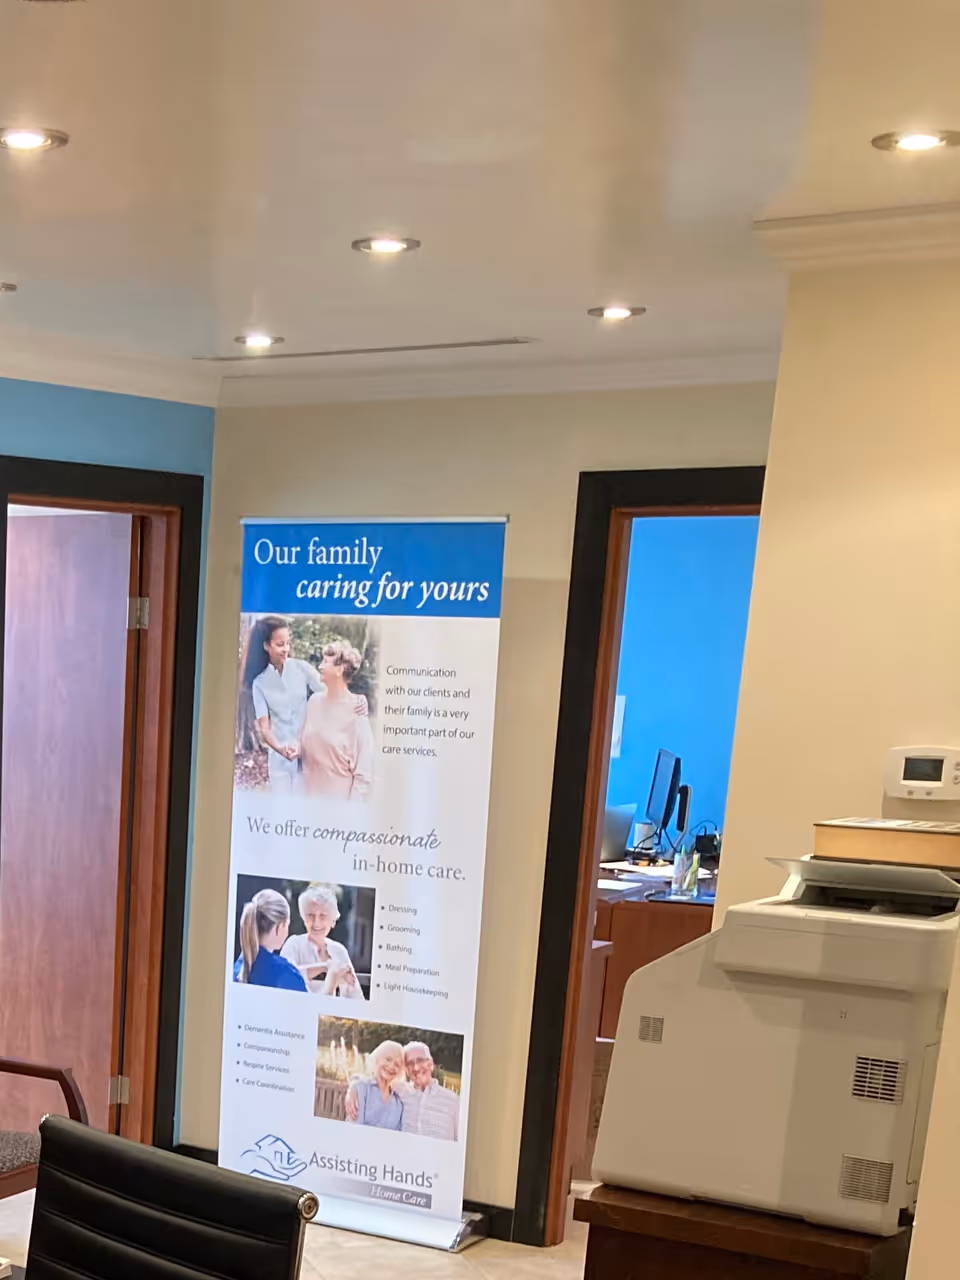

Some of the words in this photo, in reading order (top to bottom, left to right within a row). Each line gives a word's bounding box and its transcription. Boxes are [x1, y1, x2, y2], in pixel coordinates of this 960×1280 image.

[253, 538, 301, 565] Our
[307, 537, 383, 574] family
[296, 573, 374, 608] caring
[371, 571, 414, 608] for
[416, 580, 490, 609] yours
[386, 665, 457, 678] Communication
[385, 685, 406, 696] with
[407, 688, 422, 697] our
[423, 687, 451, 698] clients
[452, 688, 471, 699] and
[384, 705, 405, 716] their
[407, 705, 433, 719] family
[433, 709, 441, 718] is
[442, 710, 448, 718] a
[449, 710, 470, 722] very
[383, 724, 427, 737] important
[428, 727, 447, 739] part
[448, 728, 458, 738] of
[459, 730, 475, 739] our
[382, 745, 401, 754] care
[403, 746, 438, 757] services.
[247, 816, 271, 834] We
[274, 818, 310, 838] offer
[312, 825, 442, 853] compassionate
[352, 853, 423, 876] in-home
[427, 863, 466, 881] care.
[388, 904, 418, 916] Dressing
[387, 923, 421, 936] Grooming
[386, 943, 413, 955] Bathing
[385, 963, 402, 972] Meal
[403, 965, 440, 977] Preparation
[384, 982, 401, 992] Light
[402, 984, 449, 999] Housekeeping
[244, 1024, 273, 1035] Dementia
[274, 1028, 306, 1040] Assistance
[265, 1064, 290, 1074] Services
[242, 1077, 255, 1086] Care
[256, 1079, 295, 1093] Coordination
[309, 1151, 377, 1182] Assisting
[370, 1185, 401, 1200] Home
[402, 1192, 427, 1206] Care
